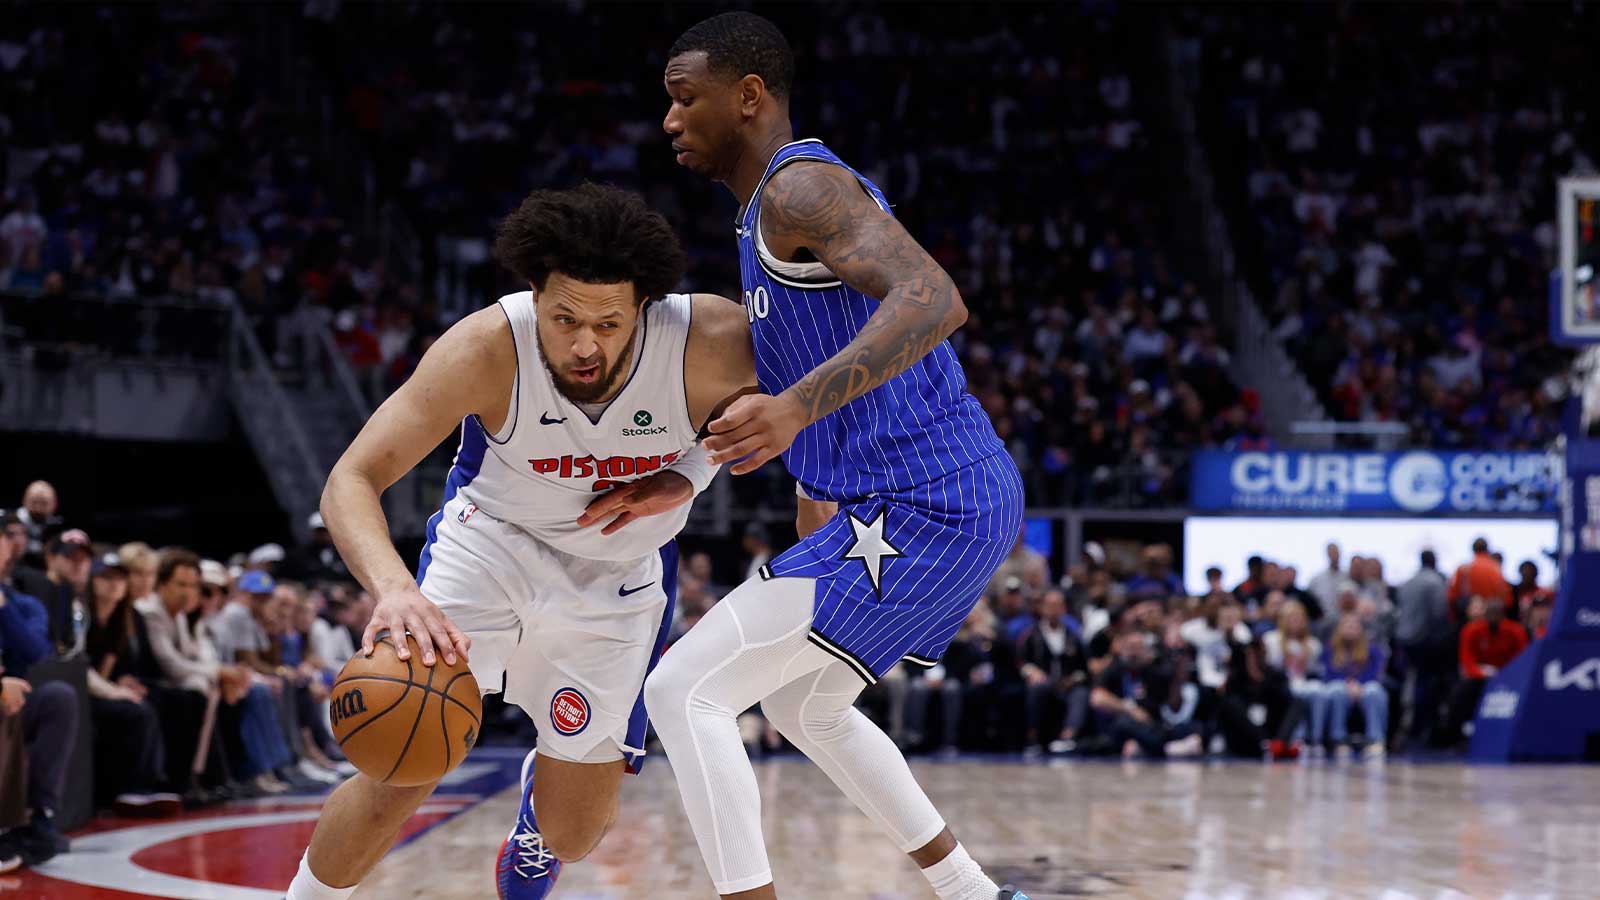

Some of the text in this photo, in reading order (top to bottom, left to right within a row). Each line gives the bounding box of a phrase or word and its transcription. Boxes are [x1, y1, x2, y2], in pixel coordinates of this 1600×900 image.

[622, 426, 667, 437] StockX
[1231, 454, 1389, 494] CURE
[556, 705, 580, 726] PISTONS
[558, 697, 583, 719] DETROIT
